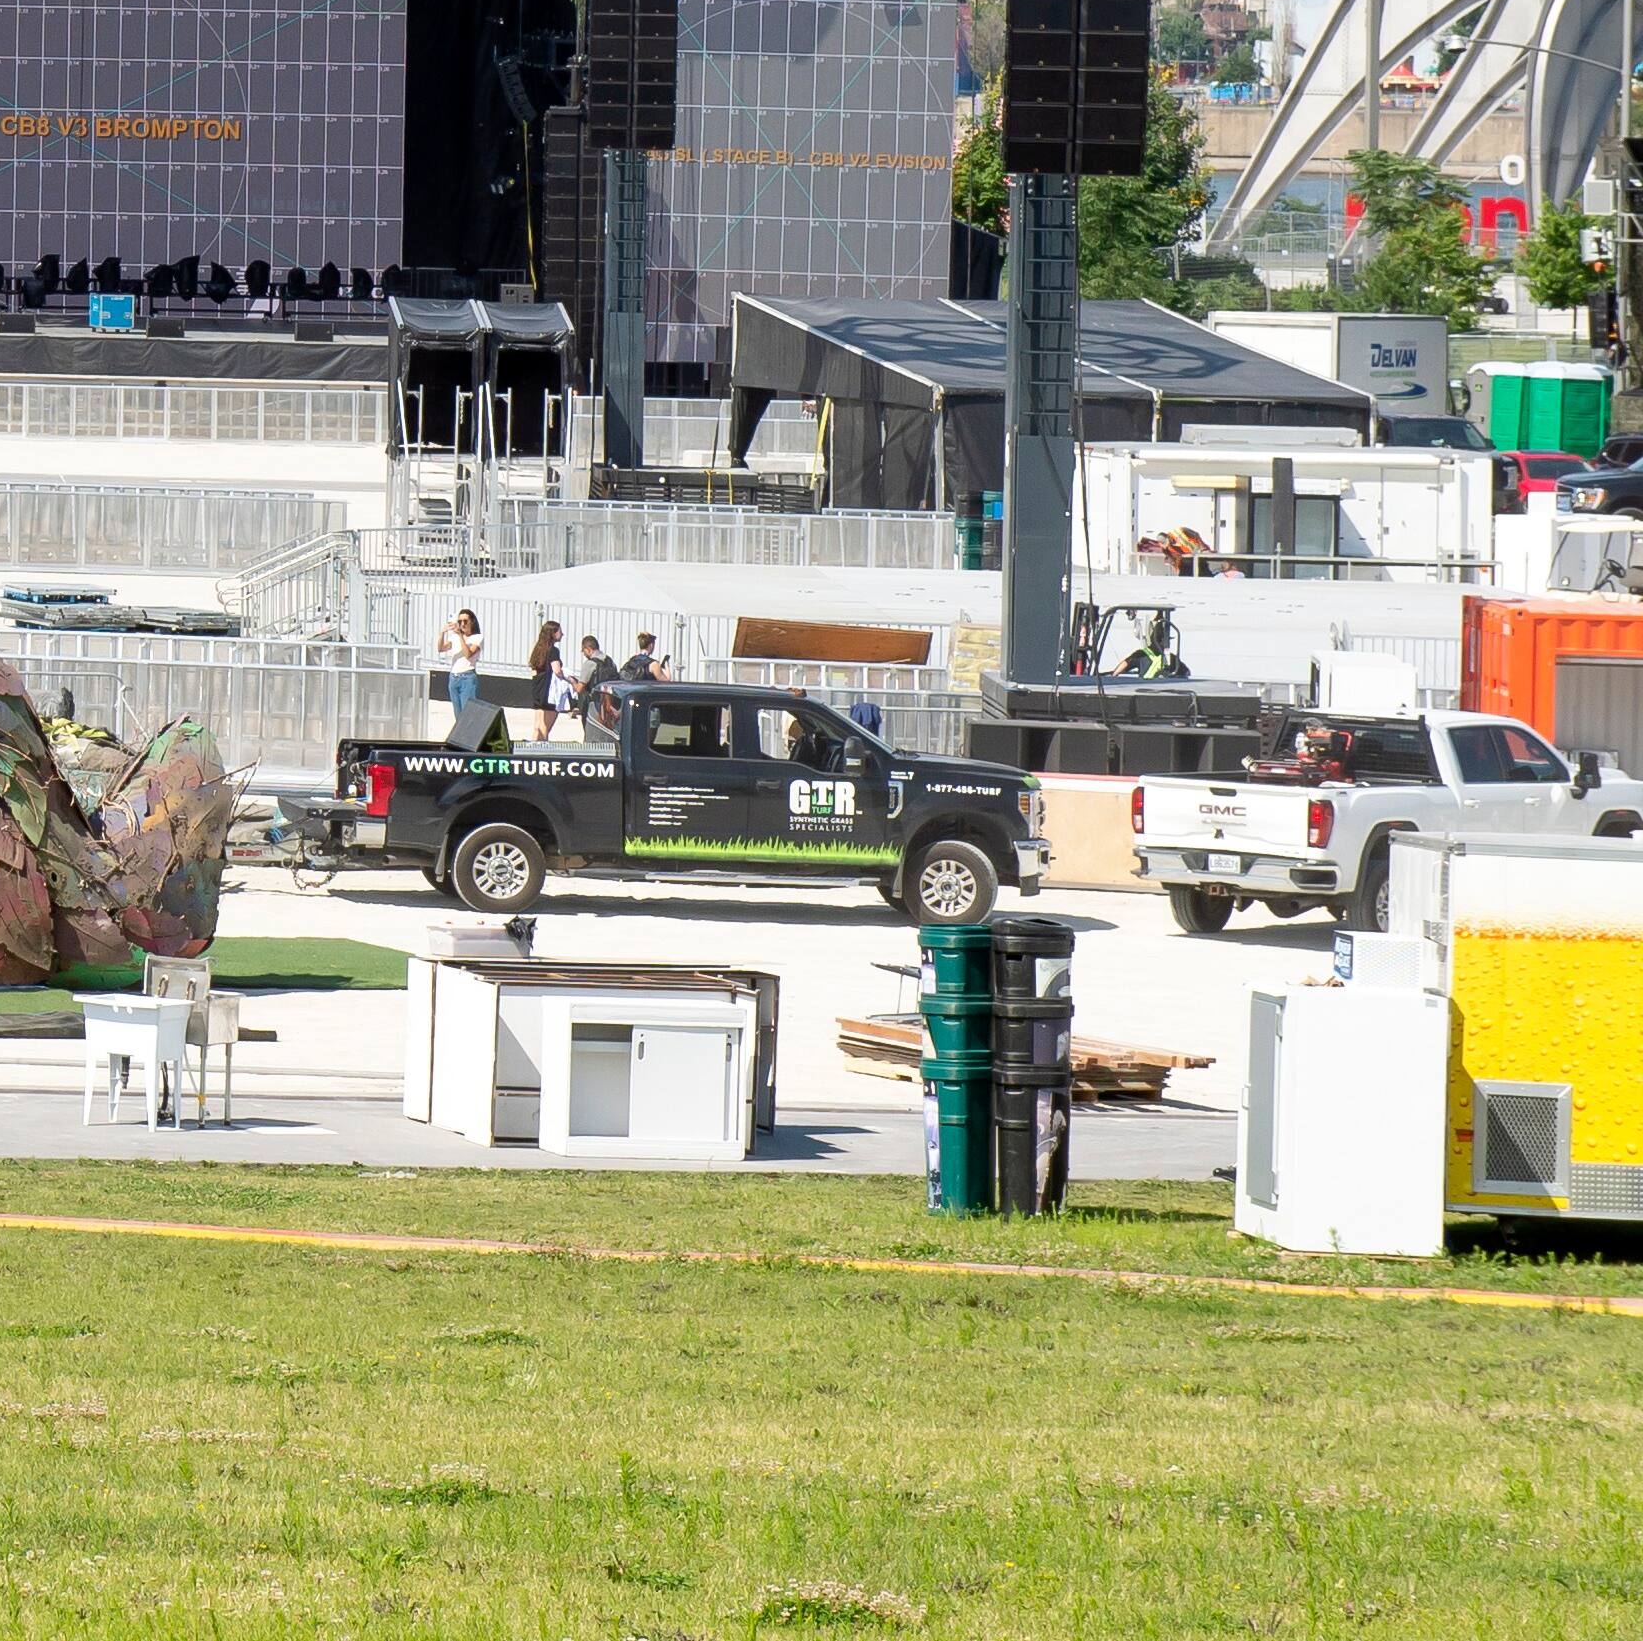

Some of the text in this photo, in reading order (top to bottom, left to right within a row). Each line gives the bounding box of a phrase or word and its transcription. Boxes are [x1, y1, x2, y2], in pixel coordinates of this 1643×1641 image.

[1, 116, 50, 138] CB8
[58, 117, 88, 138] V3
[95, 118, 241, 140] BROMPTON
[404, 756, 615, 778] WWW.GTRTURF.COM
[789, 779, 855, 816] GTR
[1198, 804, 1247, 817] GMC
[789, 816, 828, 824] SYNTHETIC
[789, 824, 854, 832] SPECIALISTS
